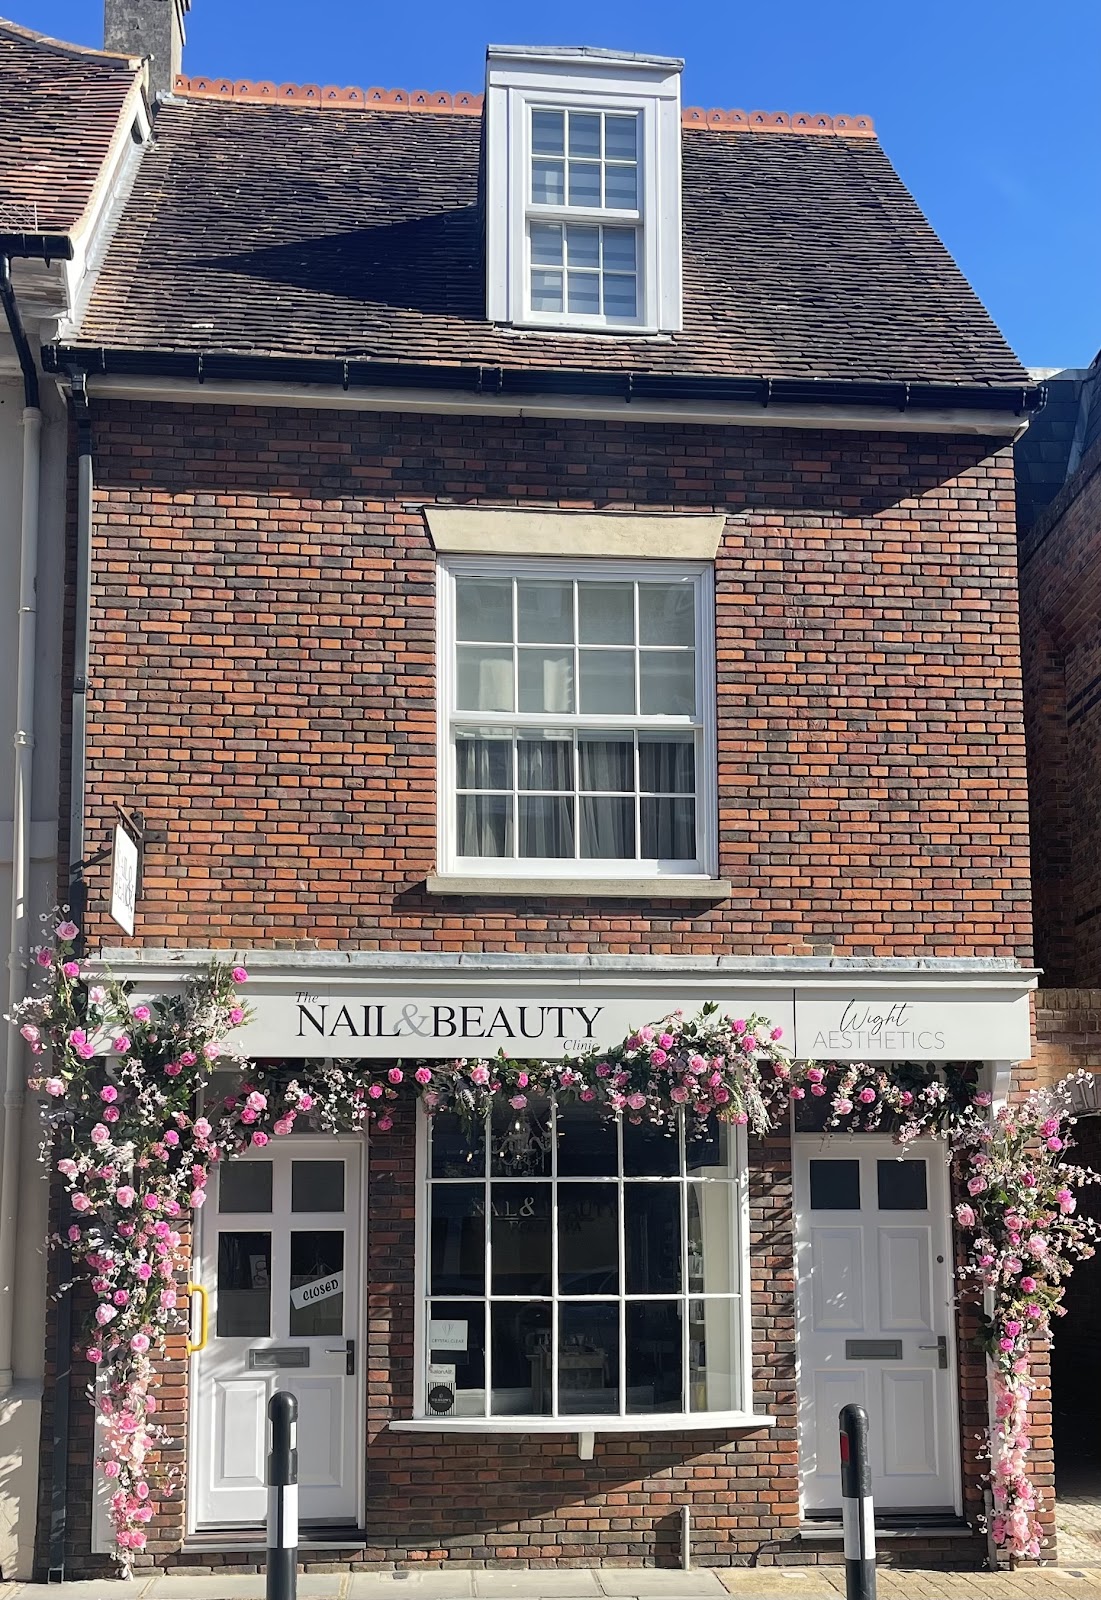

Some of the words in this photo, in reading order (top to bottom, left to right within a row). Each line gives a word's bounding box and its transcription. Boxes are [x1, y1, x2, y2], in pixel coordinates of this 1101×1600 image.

[295, 991, 319, 1003] The
[839, 998, 914, 1036] Wight
[812, 1030, 946, 1050] AESTHETICS
